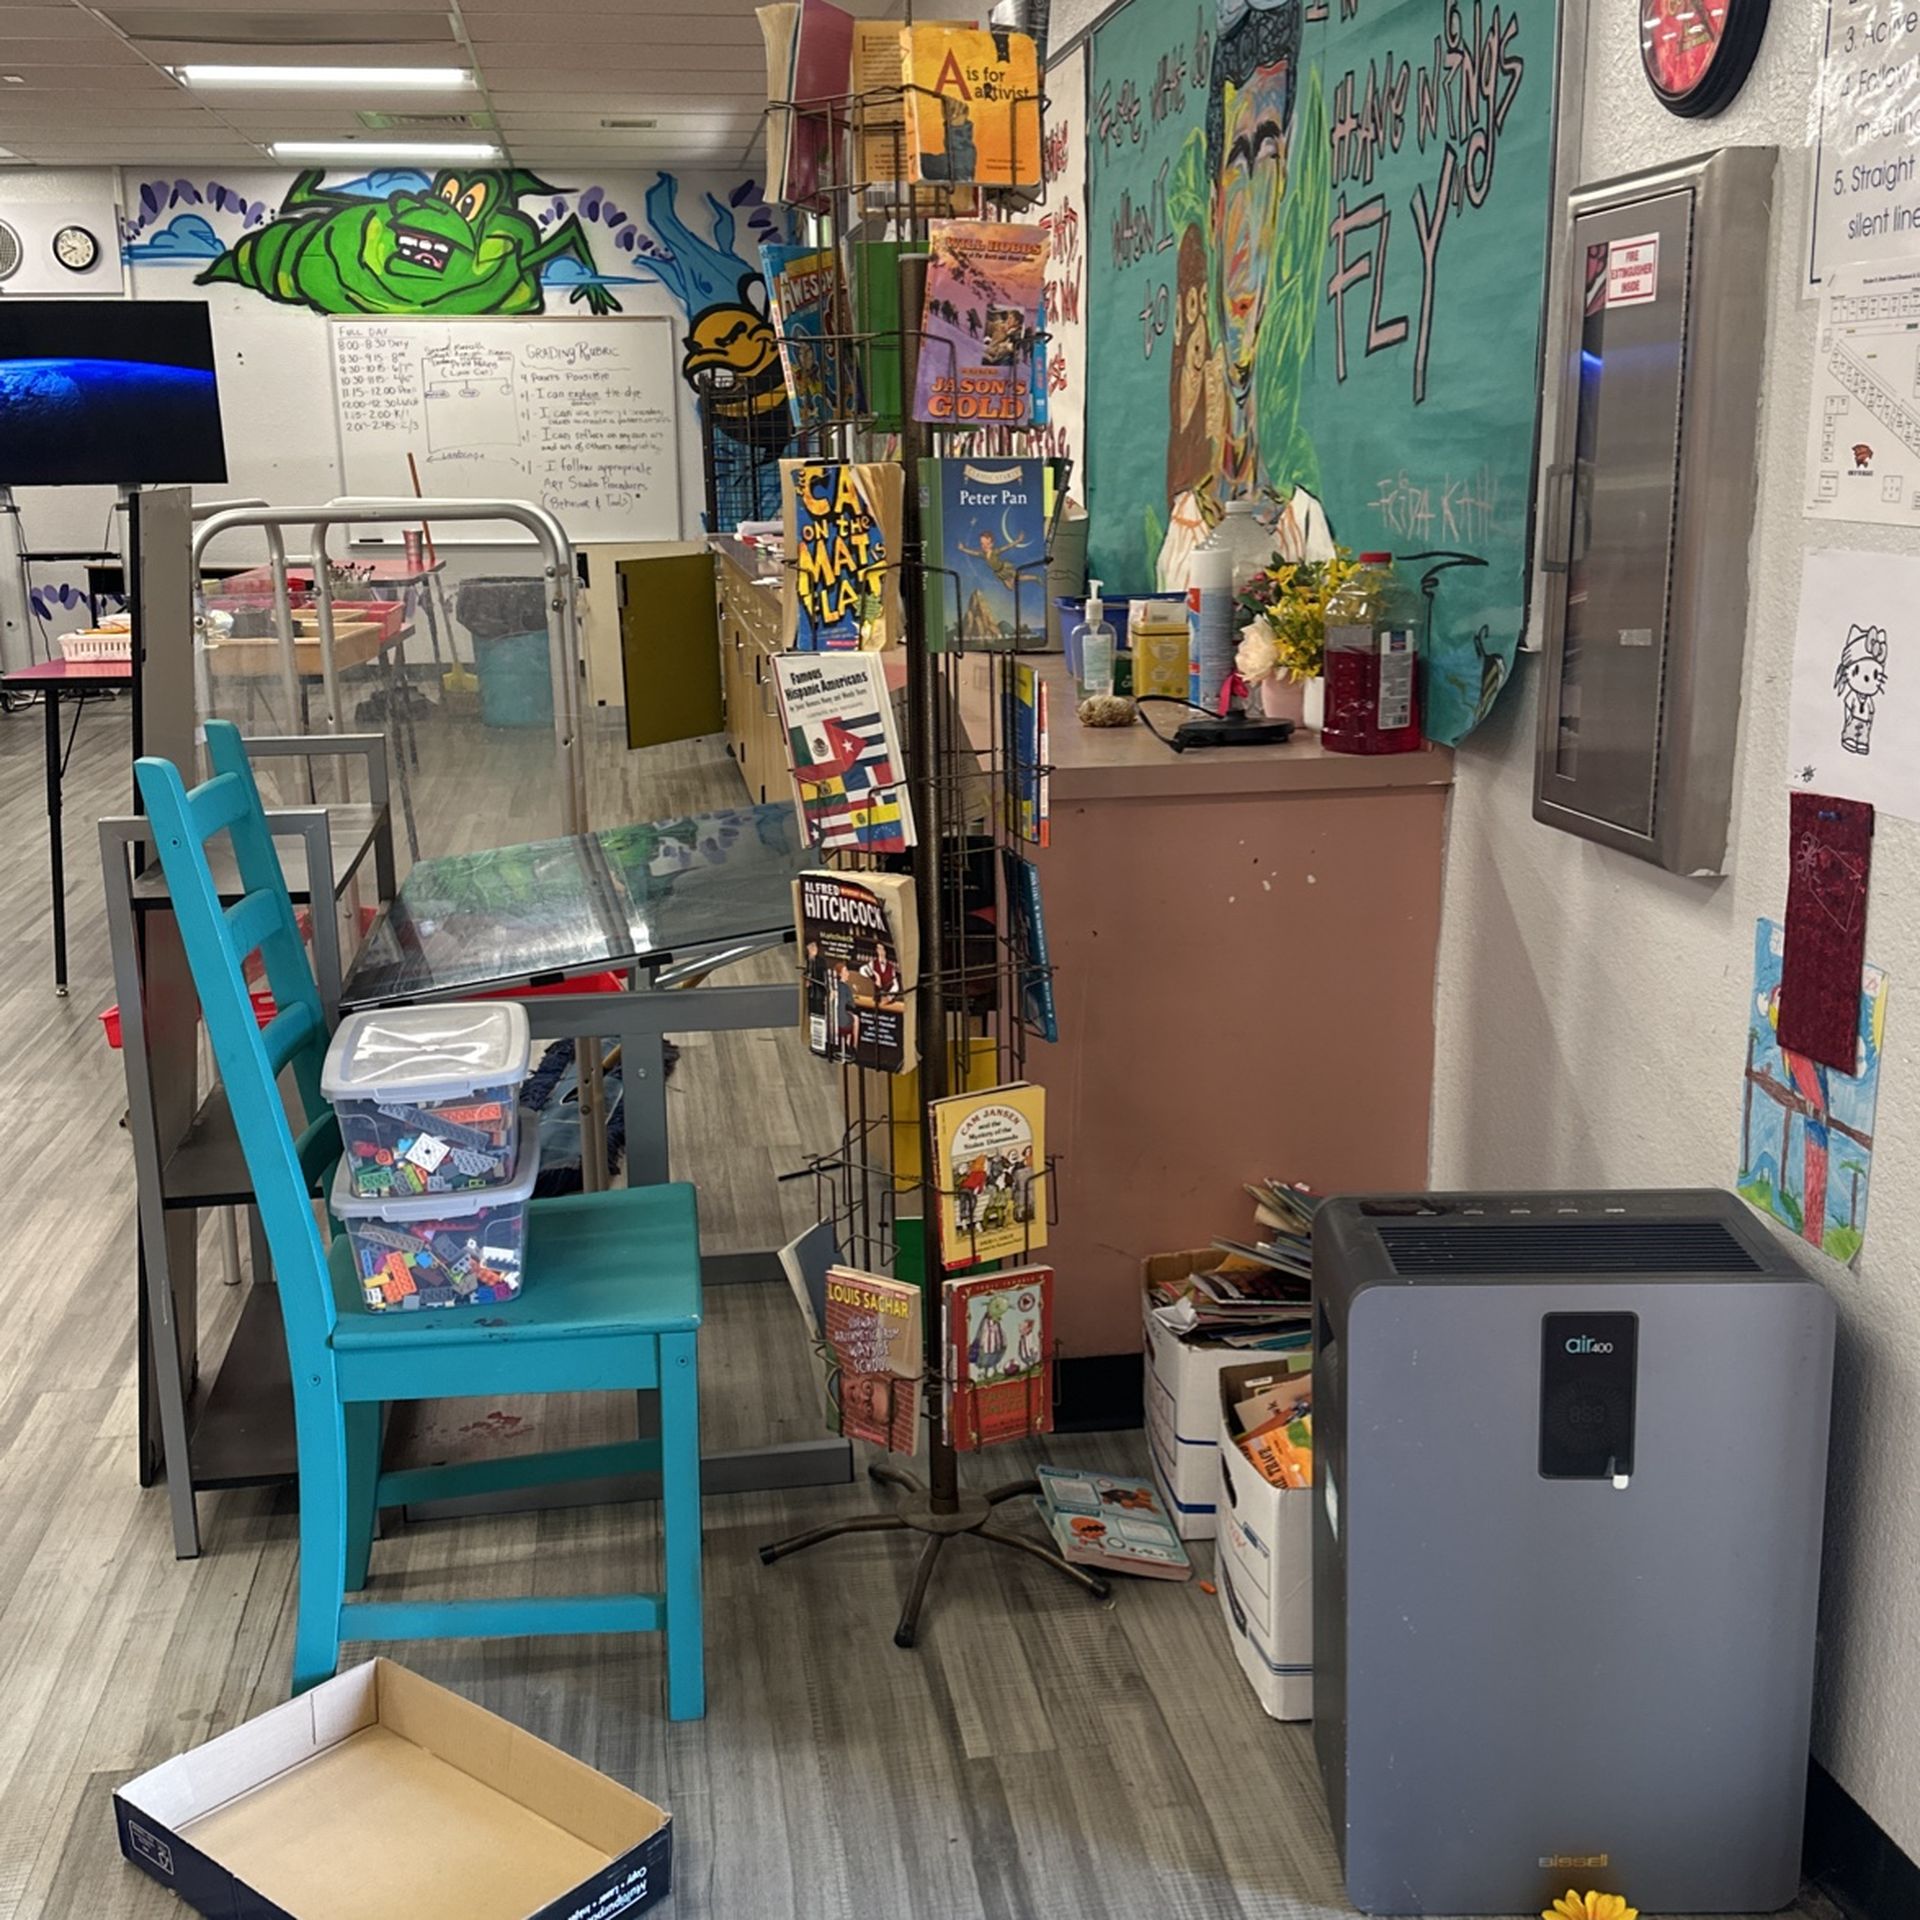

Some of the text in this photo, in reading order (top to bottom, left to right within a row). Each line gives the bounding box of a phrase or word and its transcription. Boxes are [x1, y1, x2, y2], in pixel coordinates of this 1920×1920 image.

[1844, 26, 1857, 53] 3.
[932, 48, 1005, 100] A is for
[1834, 154, 1916, 196] 5. Straight
[1848, 208, 1890, 240] silent
[1626, 250, 1640, 262] FIRE
[1327, 143, 1457, 402] FLY
[928, 395, 1025, 421] GOLD
[960, 489, 1028, 506] Peter Pan
[802, 519, 828, 541] ON
[789, 668, 823, 686] Famous
[820, 671, 869, 693] Americans
[804, 881, 841, 897] ALFRED
[804, 893, 888, 933] HITCHCOCK
[961, 1109, 1021, 1137] CAM JANSEN
[828, 1282, 861, 1307] LOUIS
[863, 1292, 909, 1319] SACHAR
[626, 1866, 648, 1885] Copy
